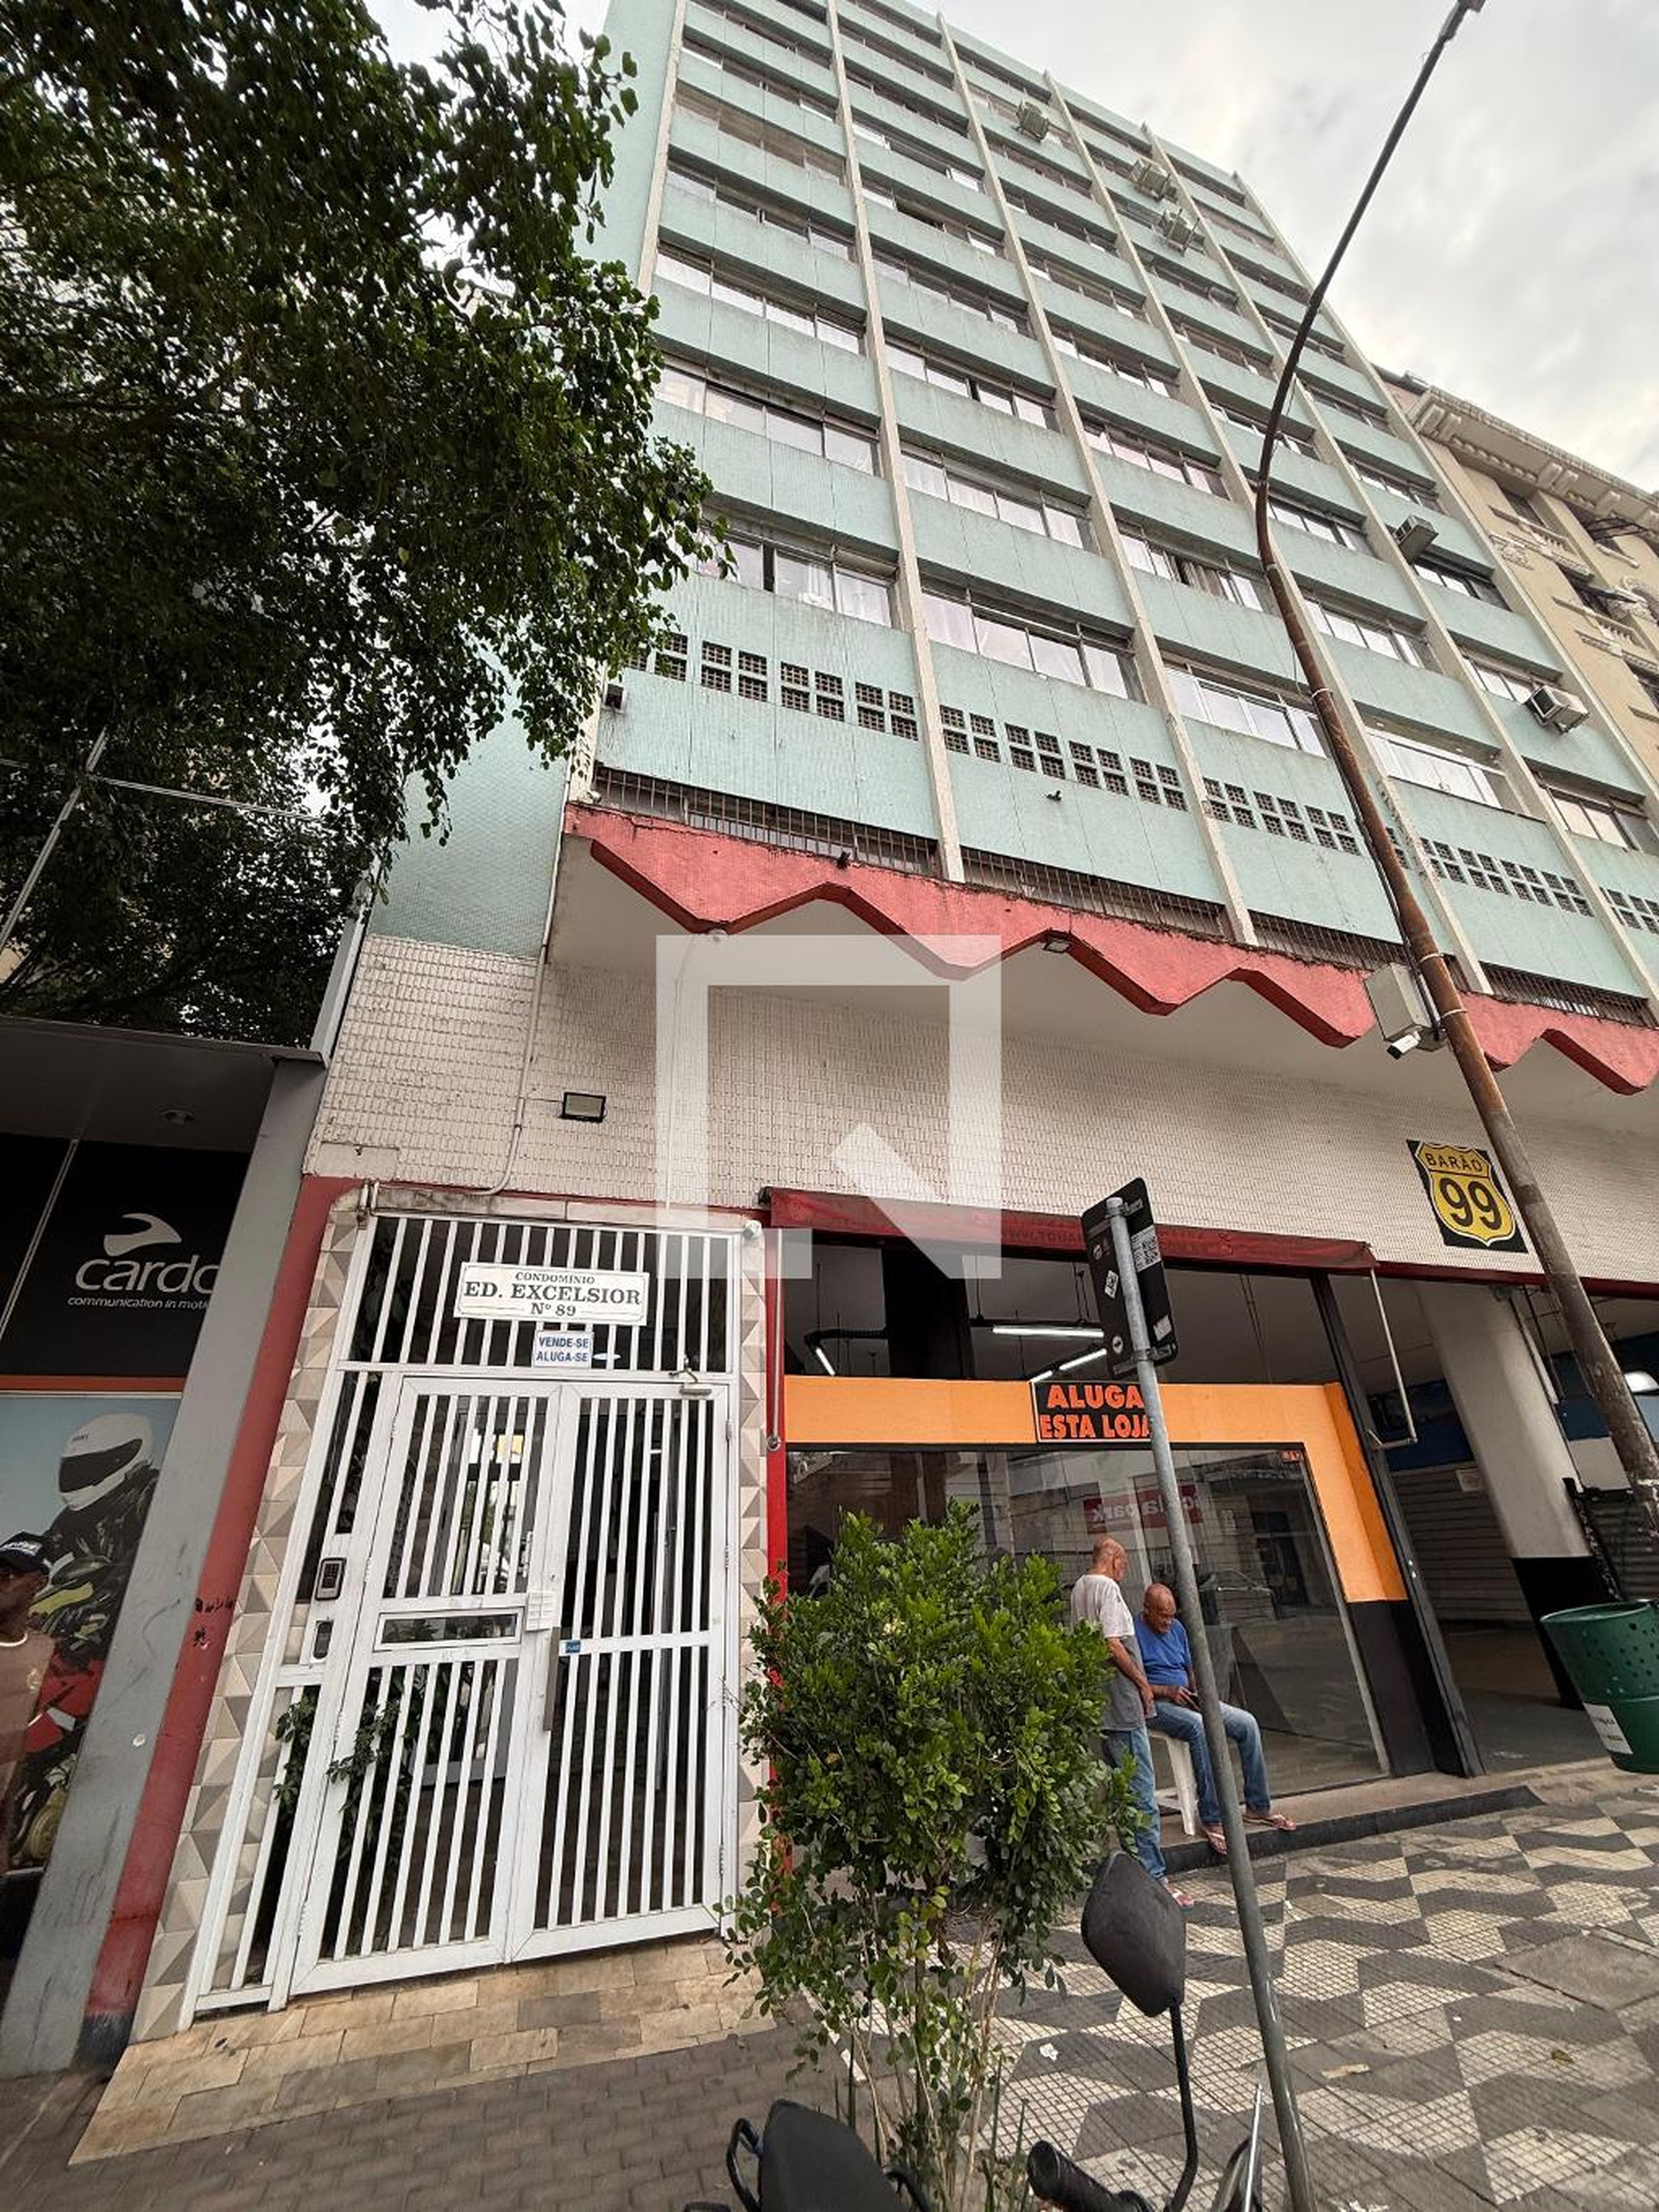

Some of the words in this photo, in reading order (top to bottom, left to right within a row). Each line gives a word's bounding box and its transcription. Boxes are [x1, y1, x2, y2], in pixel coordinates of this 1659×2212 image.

[1425, 1153, 1483, 1172] BARÃO
[1439, 1178, 1503, 1231] 99
[68, 1297, 162, 1308] communication
[165, 1300, 176, 1308] in
[463, 1281, 502, 1298] ED.
[510, 1283, 642, 1305] EXCELSIOR
[555, 1305, 577, 1317] 89
[538, 1336, 589, 1349] VENDE-SE
[536, 1352, 589, 1362] ALUGA-SE
[1047, 1384, 1145, 1409] ALUGA
[1039, 1414, 1096, 1440] ESTA
